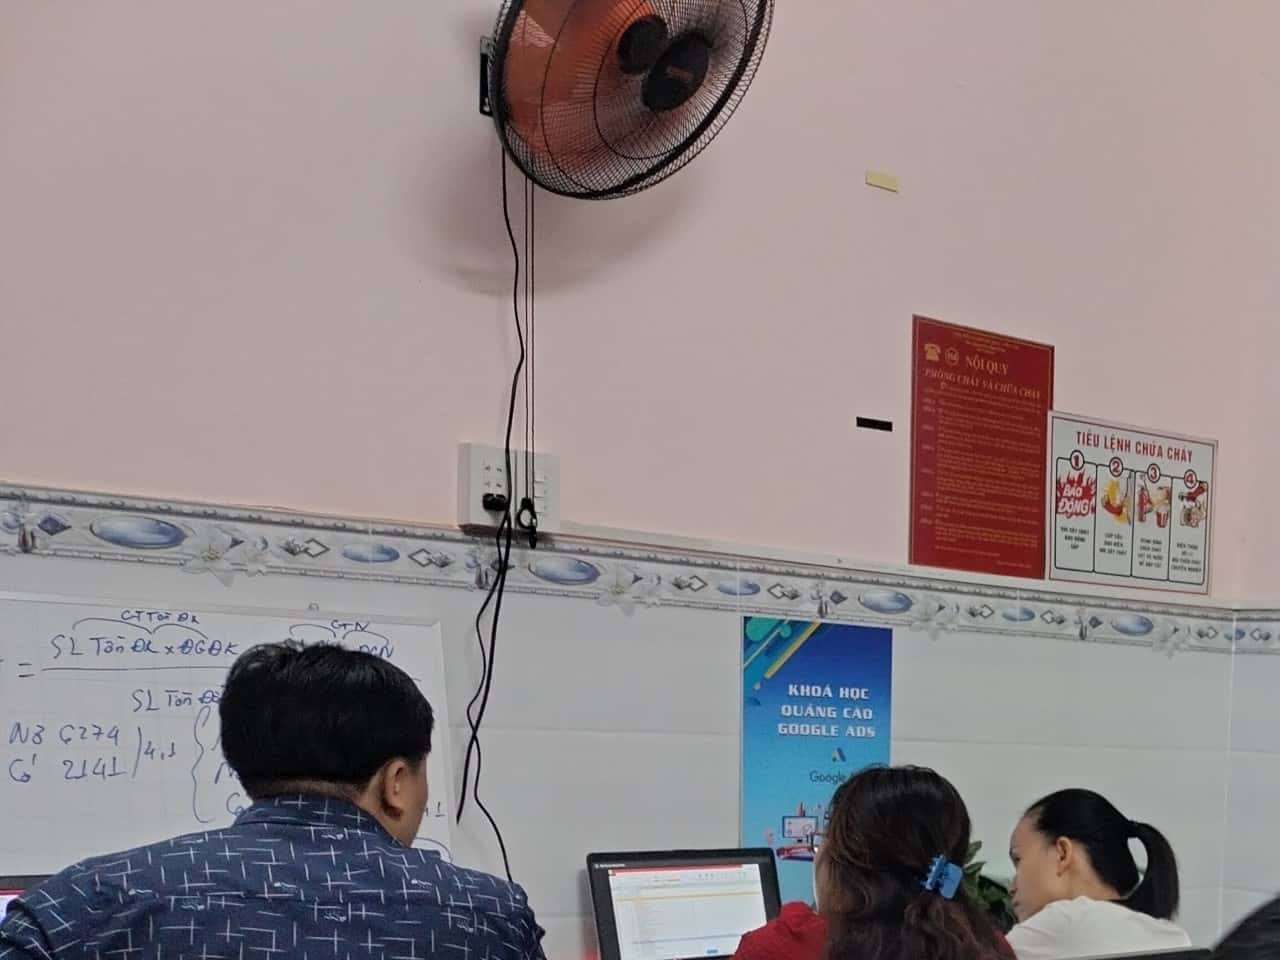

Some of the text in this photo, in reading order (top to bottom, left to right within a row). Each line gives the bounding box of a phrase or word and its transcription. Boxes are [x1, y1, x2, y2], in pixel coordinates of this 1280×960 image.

[986, 360, 1008, 376] QUY
[1104, 434, 1131, 453] LỆNH
[1135, 440, 1163, 458] CHỮA
[1167, 447, 1193, 463] CHÁY
[1058, 498, 1089, 517] ĐỘNG
[50, 637, 83, 659] SL
[132, 688, 160, 712] SL
[839, 687, 869, 701] HỌC
[843, 707, 874, 720] CAO
[778, 722, 876, 738] GOOGLE ADS
[809, 770, 846, 786] Google
